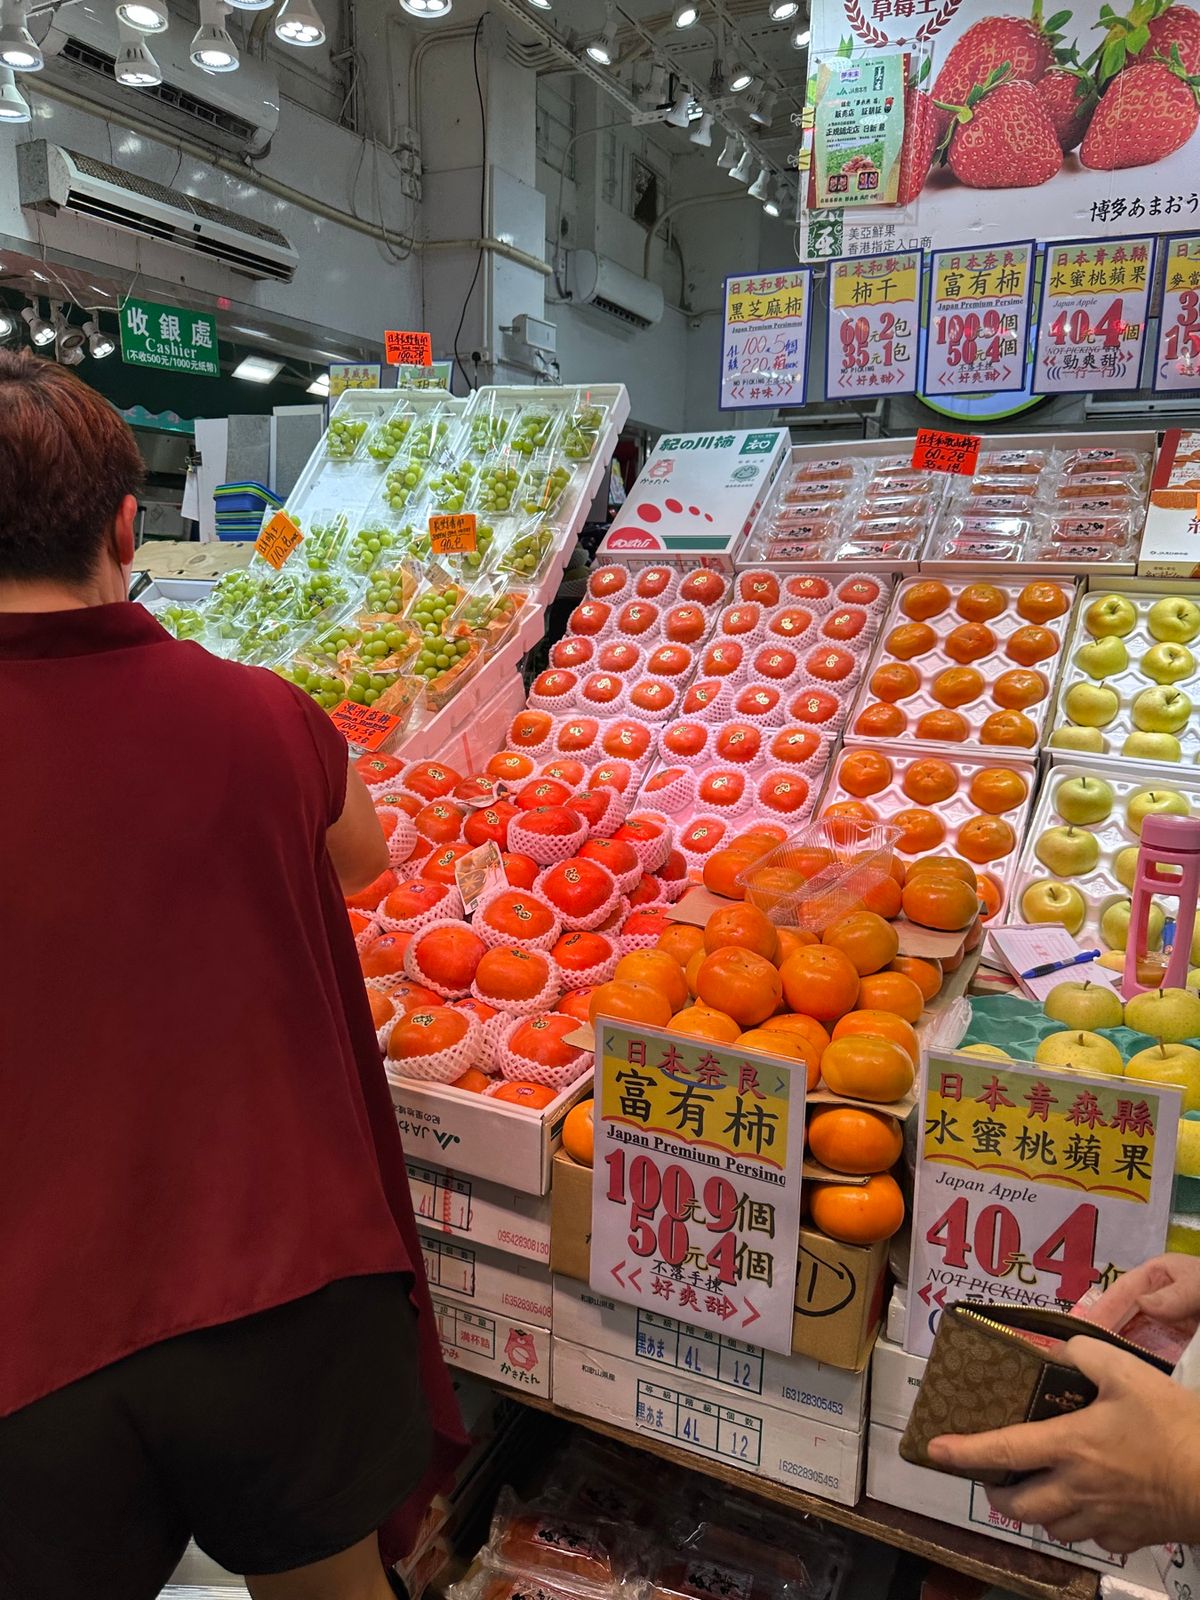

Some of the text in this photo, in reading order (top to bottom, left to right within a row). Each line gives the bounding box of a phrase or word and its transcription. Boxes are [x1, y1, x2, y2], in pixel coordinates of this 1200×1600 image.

[1089, 193, 1199, 222] 博多あまおう
[848, 224, 896, 241] 美亞鮮果
[847, 236, 933, 256] 香港指定入口商
[1056, 243, 1148, 267] 日本青森縣
[834, 256, 916, 278] 日本和歌山
[950, 250, 1017, 270] 日本奈良
[730, 275, 803, 295] 日本和歌山
[943, 268, 1022, 297] 富有柿
[1050, 265, 1147, 289] 水蜜桃蘋果
[852, 278, 898, 304] 柿干
[1053, 297, 1098, 308] Japan Apple
[729, 297, 803, 320] 黑芝麻柿
[937, 302, 959, 311] Japan
[960, 299, 993, 309] Premium
[127, 307, 212, 348] 收銀處
[748, 322, 774, 332] Premium
[145, 337, 197, 359] Cashier
[126, 349, 217, 374] (不收500元/1000元紙幣)
[750, 387, 774, 400] 好味
[659, 435, 736, 452] 紀の川柿
[627, 1039, 767, 1100] 日本奈良
[615, 1068, 779, 1154] 富有柿
[939, 1073, 1155, 1137] 日本青森縣
[606, 1124, 650, 1147] Japan
[653, 1137, 721, 1167] Premium
[925, 1110, 1152, 1181] 水蜜桃蘋果
[936, 1172, 1038, 1204] Japan Apple
[926, 1267, 968, 1289] NOT
[968, 1277, 1051, 1307] PICKING
[580, 1294, 616, 1311] 和歌山県産
[651, 1278, 735, 1321] 好爽甜
[637, 1331, 751, 1387] 黒あま 4L 12
[500, 1363, 541, 1384] かきたん
[581, 1364, 616, 1382] 和歌山県産
[782, 1385, 843, 1416] 163128305453
[637, 1401, 749, 1458] 黒あま 4L 12
[778, 1458, 840, 1490] 162628305453
